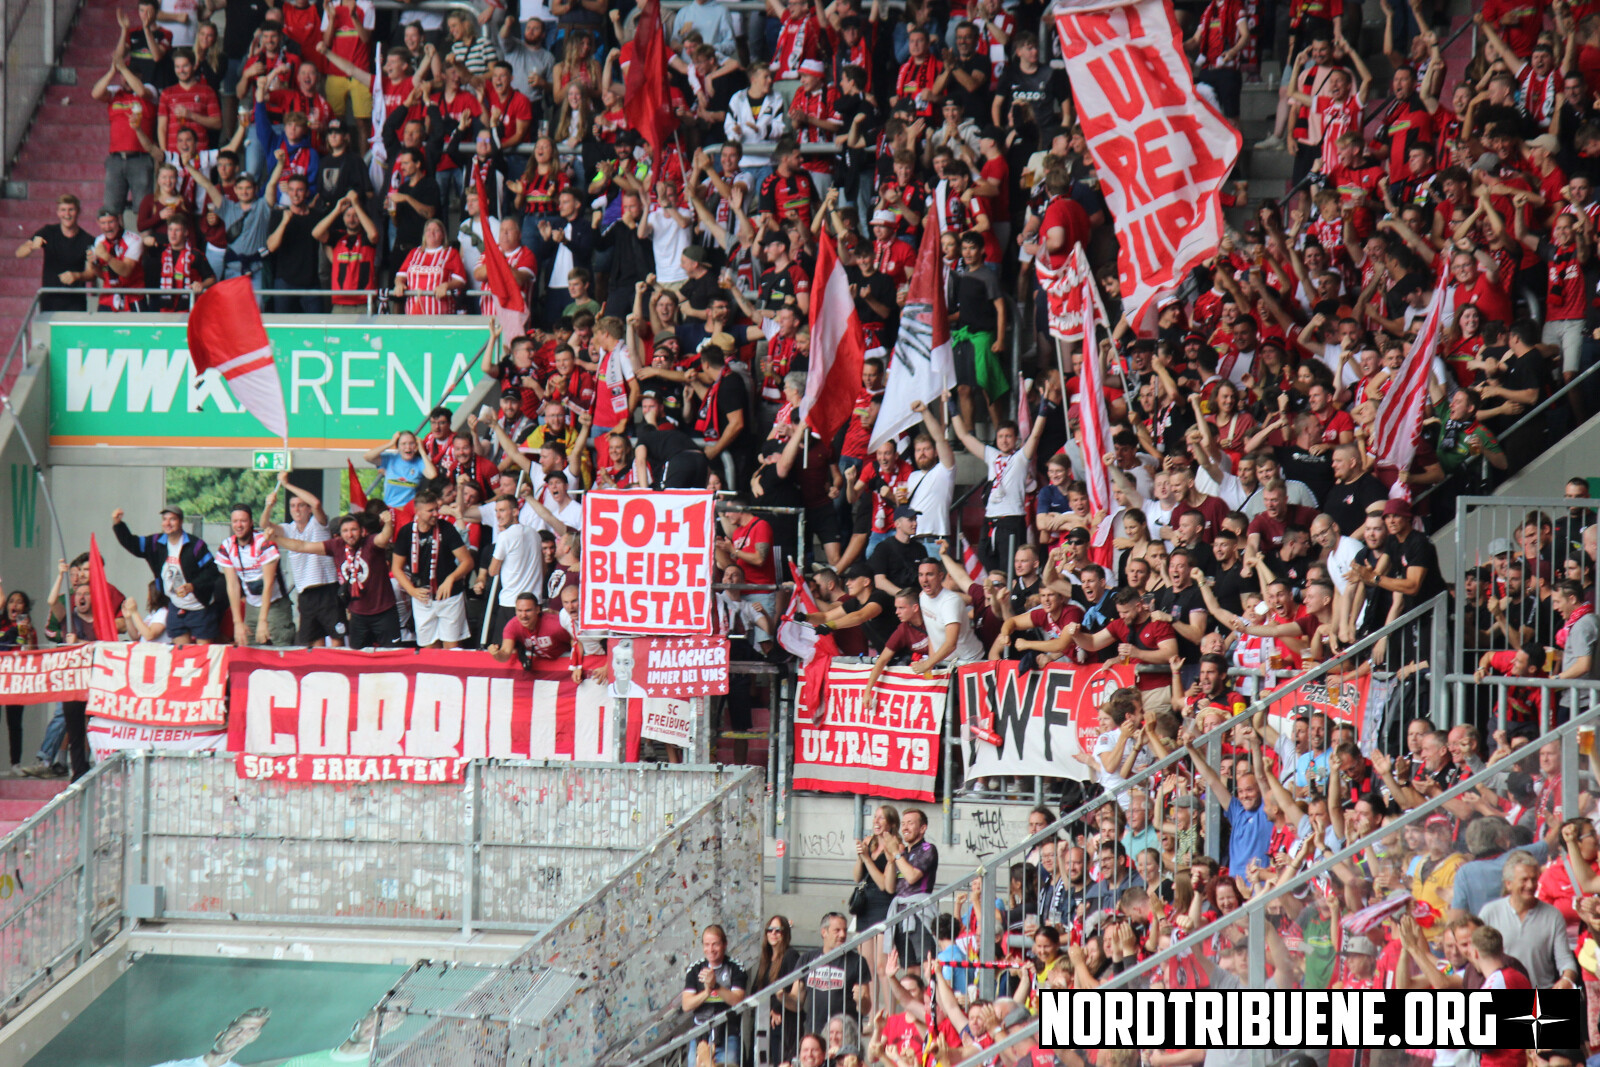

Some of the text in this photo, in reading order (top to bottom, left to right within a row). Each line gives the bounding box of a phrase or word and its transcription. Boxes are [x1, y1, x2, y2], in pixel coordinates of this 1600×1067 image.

[66, 348, 475, 416] WWK RENA
[590, 498, 707, 549] 50+1
[590, 552, 706, 587] BLEIBT.
[590, 589, 705, 626] BASTA!
[0, 643, 94, 673] ALL MUSS
[88, 641, 227, 699] 50+1
[648, 647, 727, 669] MALOCHER
[50, 667, 92, 693] SEIN
[647, 667, 727, 685] IMMER BEI UNS
[86, 690, 228, 724] ERHALTEN!
[244, 668, 615, 762] CORRILLO
[667, 703, 679, 716] SC
[797, 682, 937, 731] SNTHESIA
[111, 725, 194, 742] WIR LIEBEN
[801, 728, 930, 771] ULTRAS 79
[243, 755, 298, 779] 50+1
